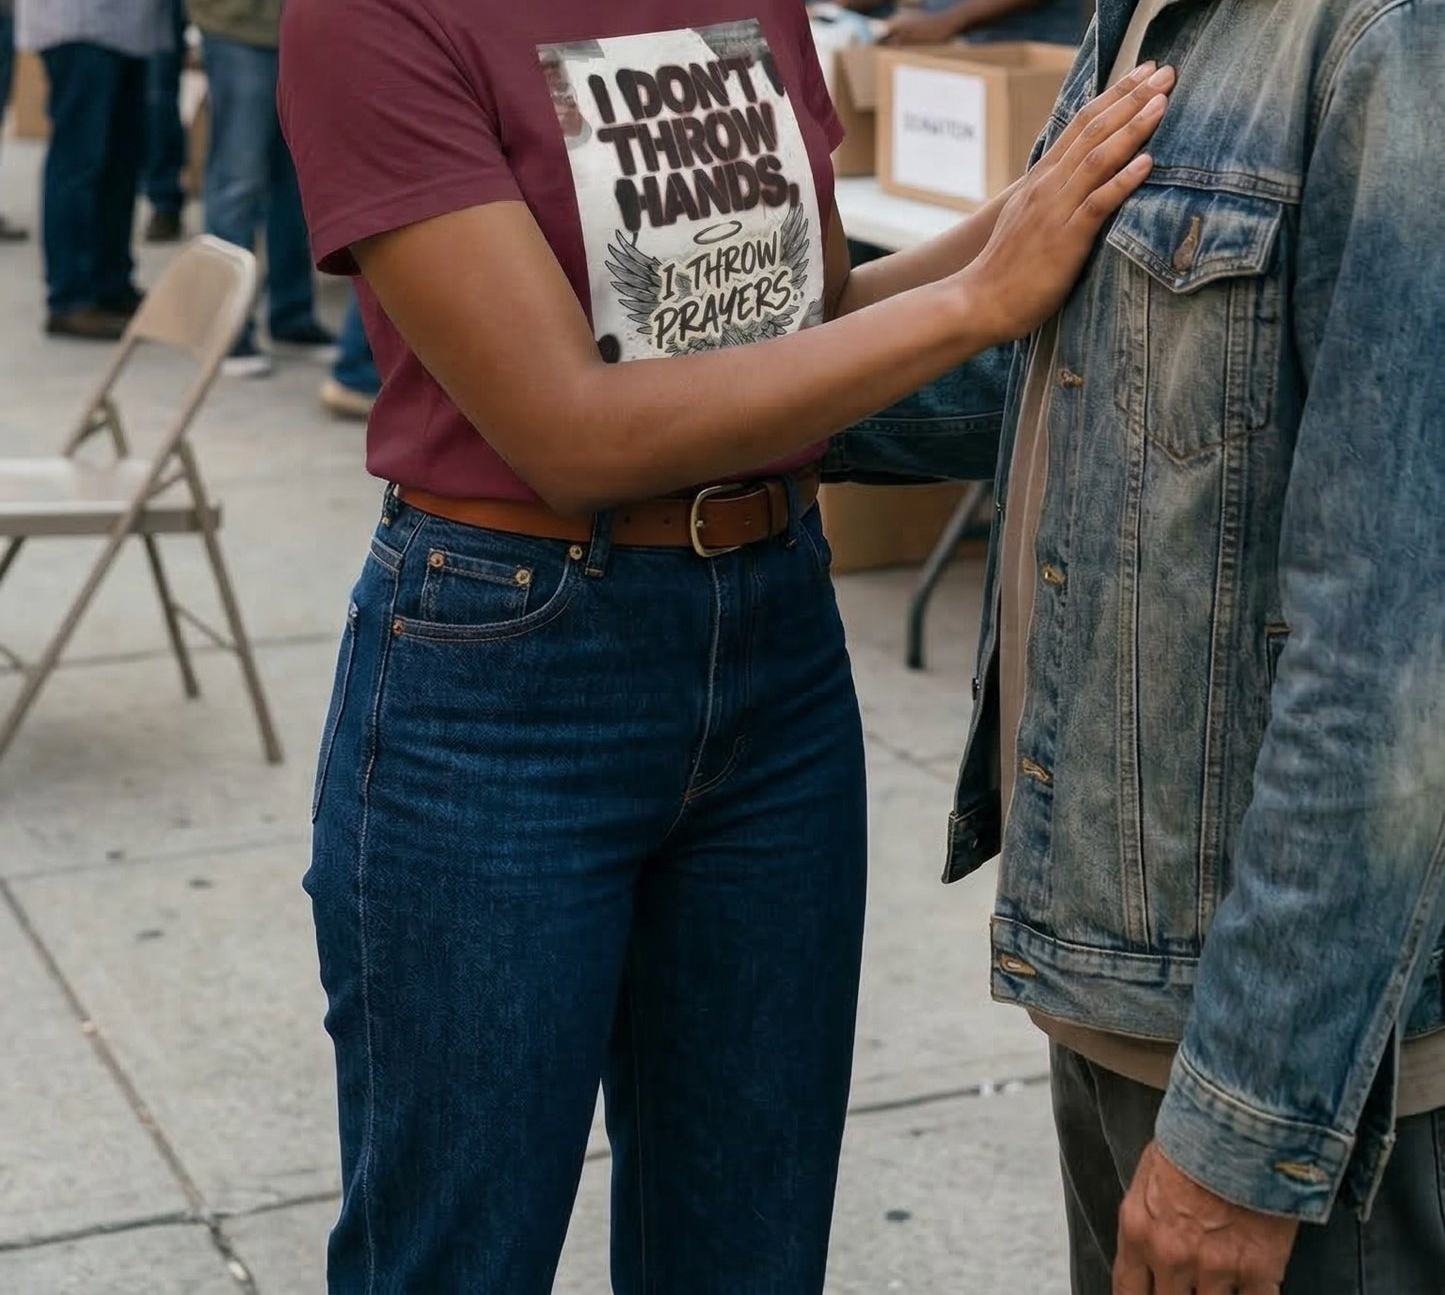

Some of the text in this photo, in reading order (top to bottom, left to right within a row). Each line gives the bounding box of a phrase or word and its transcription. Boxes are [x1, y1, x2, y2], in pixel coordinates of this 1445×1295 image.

[587, 56, 760, 125] I DON'T
[596, 101, 779, 177] THROW
[614, 154, 801, 233] HANDS,
[660, 230, 779, 302] I THROW
[653, 269, 792, 350] PRAYERS
